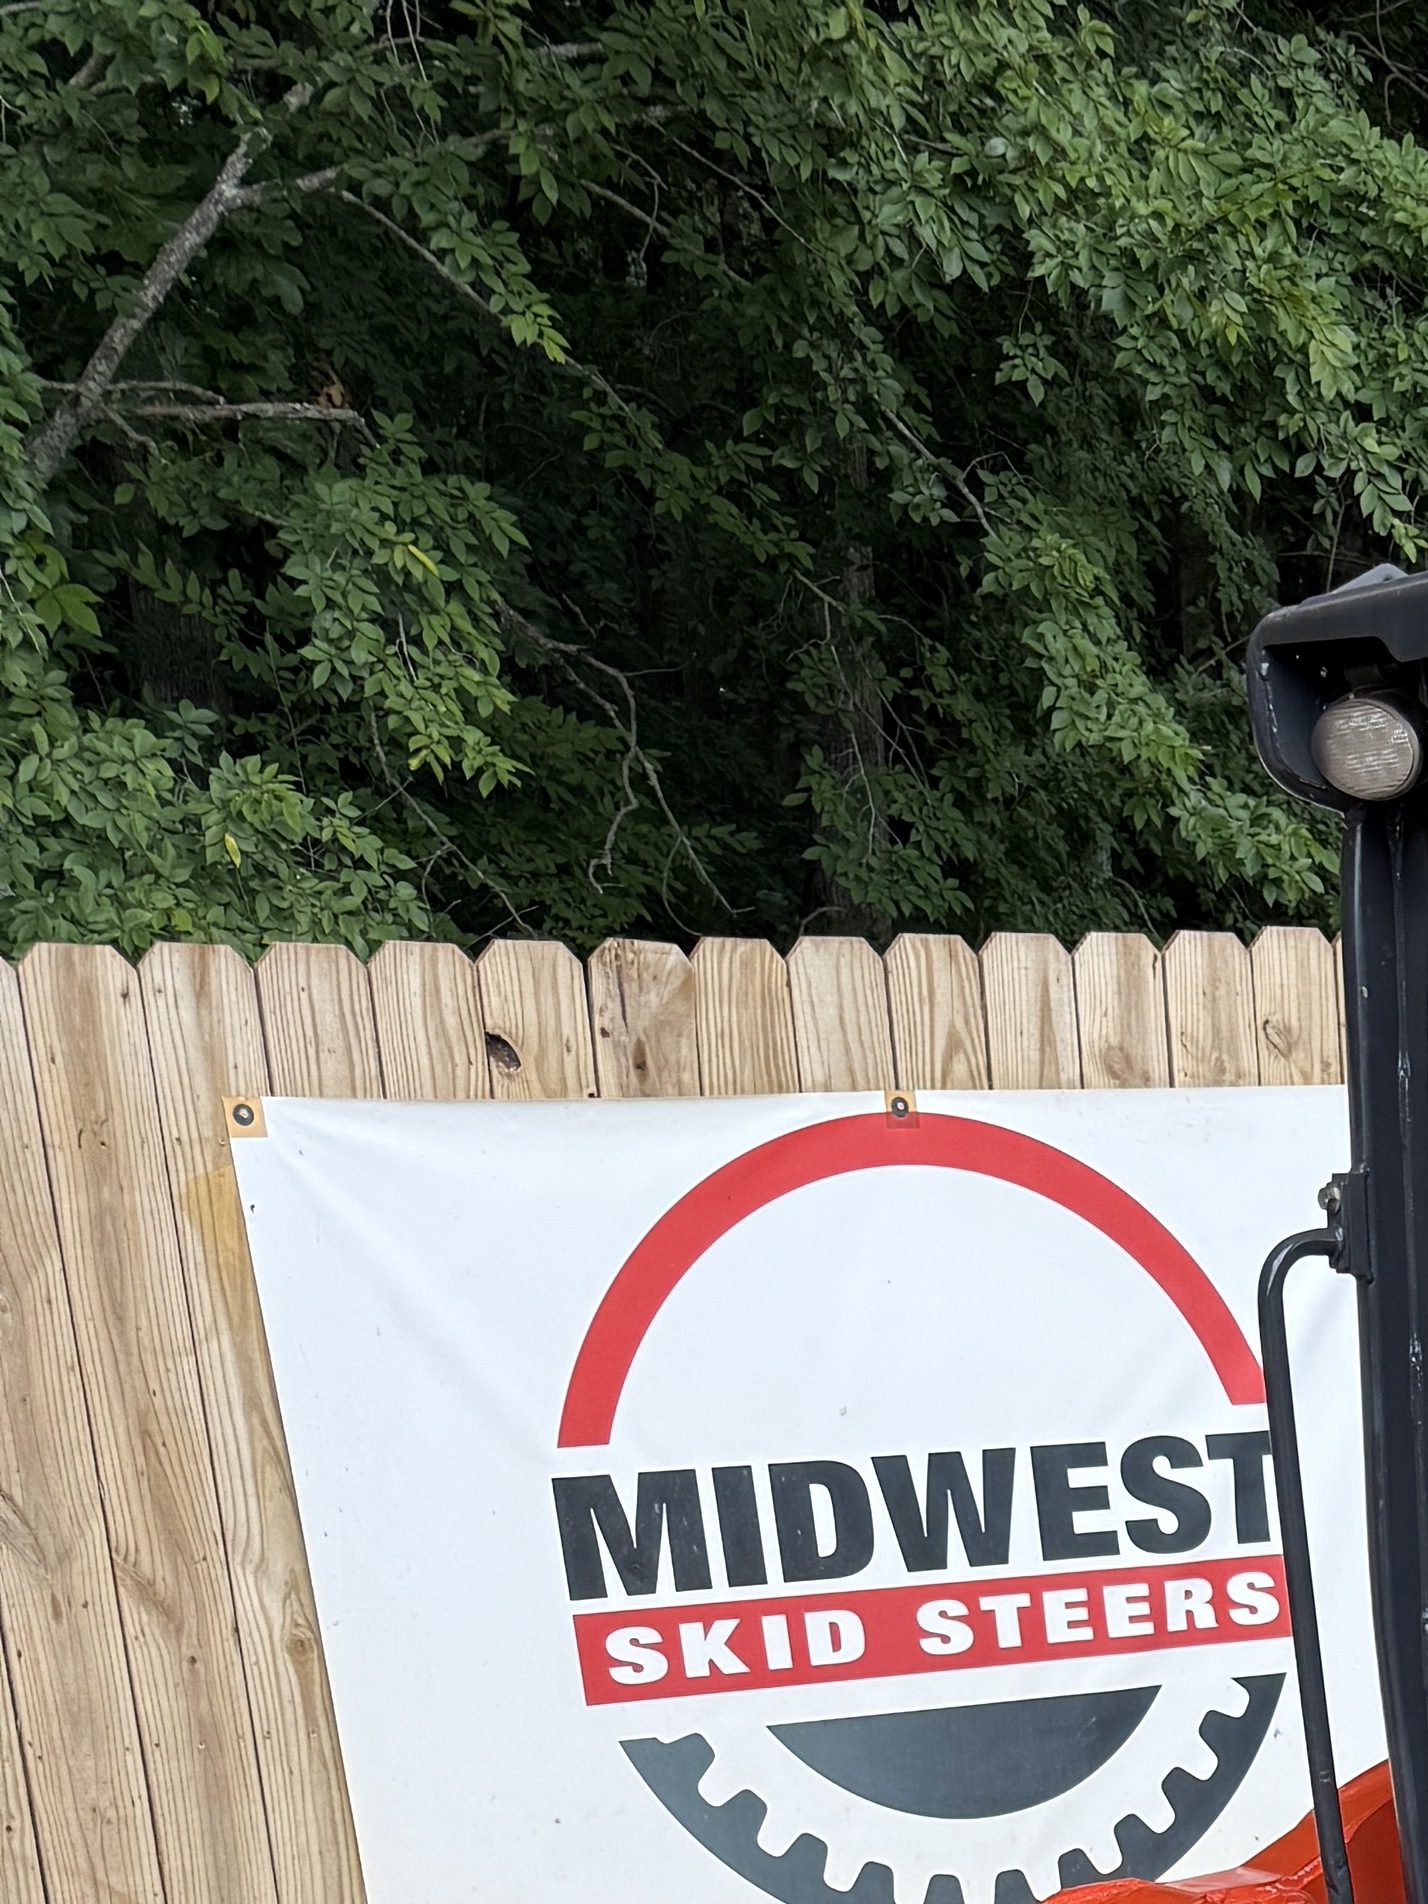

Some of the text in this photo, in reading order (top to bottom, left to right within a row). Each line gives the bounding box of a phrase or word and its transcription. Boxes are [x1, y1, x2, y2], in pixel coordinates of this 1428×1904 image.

[551, 1431, 1272, 1601] MIDWEST
[605, 1571, 1281, 1686] SKID STEERS
